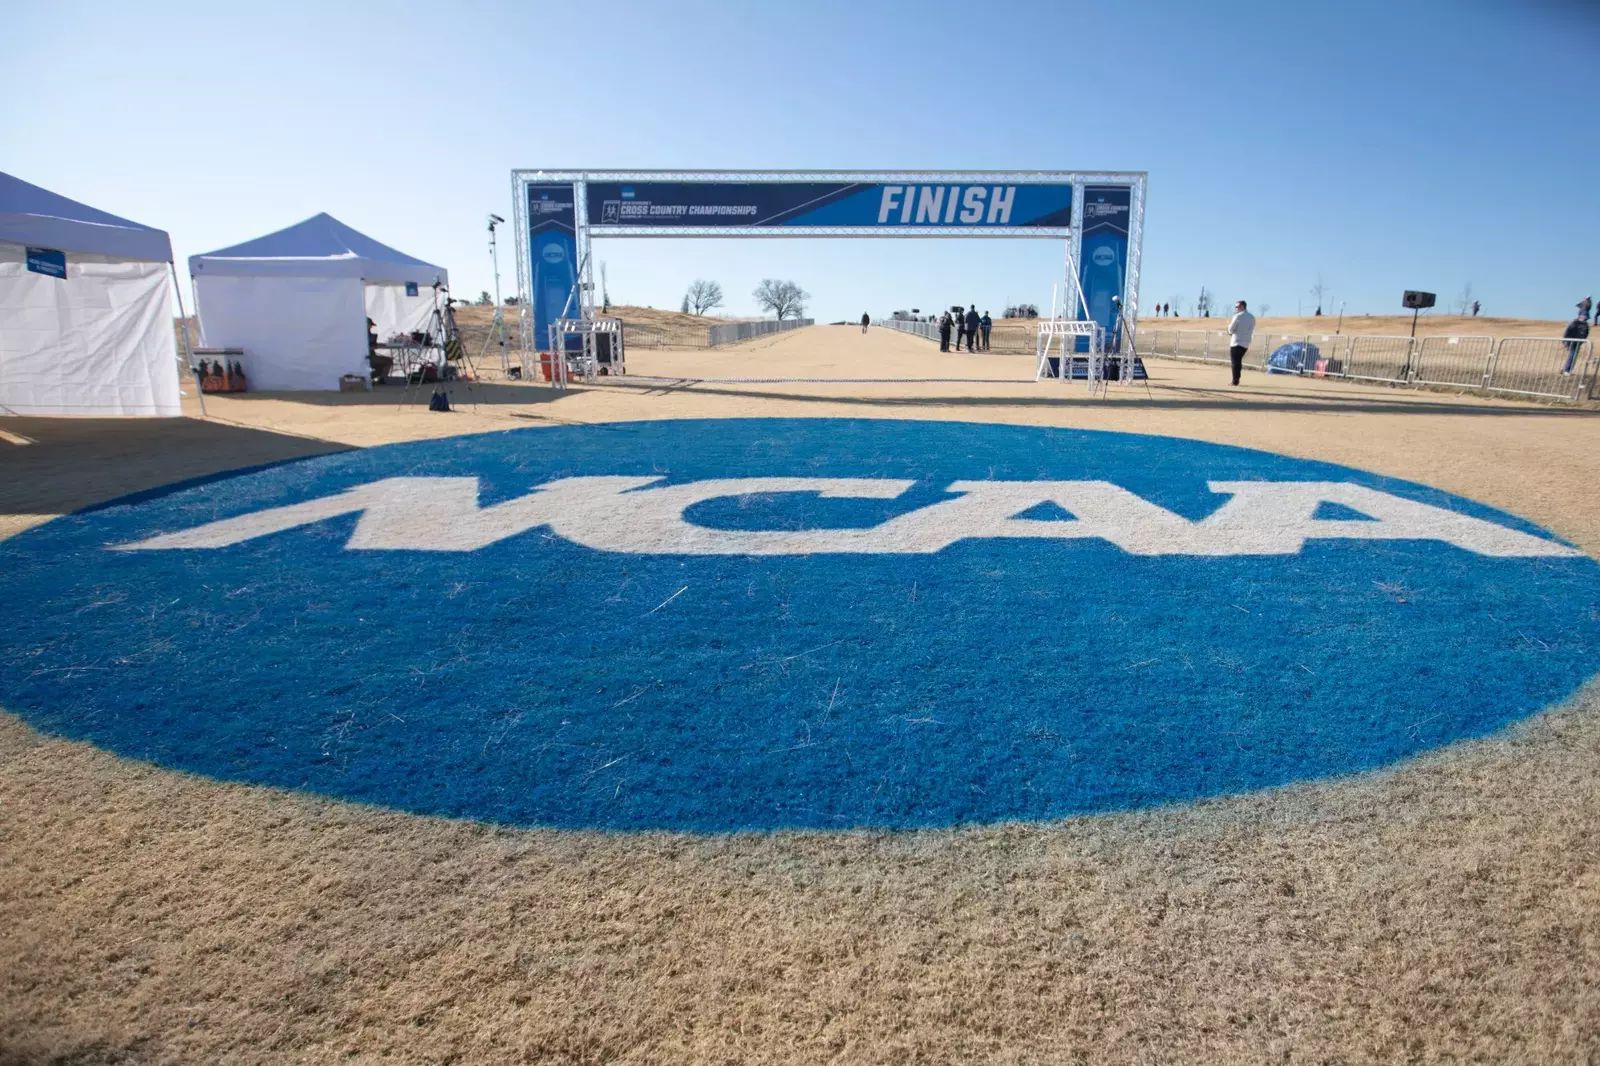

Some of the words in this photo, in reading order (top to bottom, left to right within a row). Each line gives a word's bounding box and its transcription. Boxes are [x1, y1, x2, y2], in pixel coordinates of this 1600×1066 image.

[620, 205, 648, 215] CROSS
[649, 205, 688, 215] COUNTRY
[688, 205, 758, 215] CHAMPIONSHIPS
[878, 186, 1016, 224] FINISH
[104, 475, 1586, 557] NCAA
